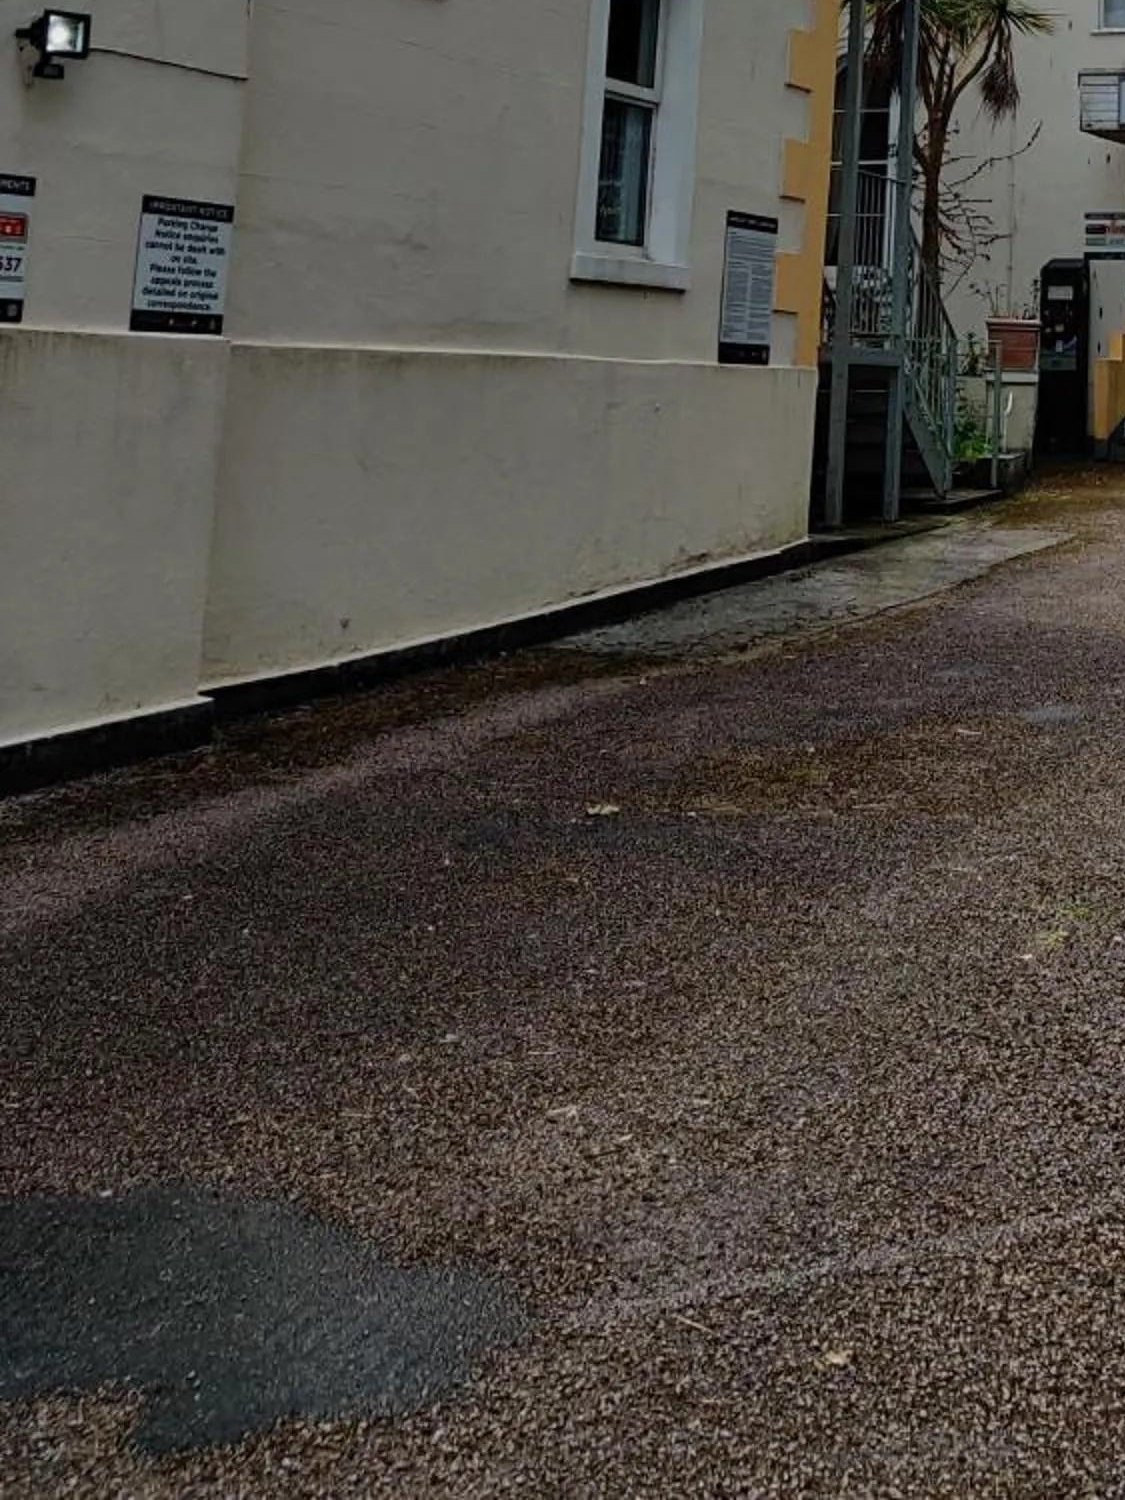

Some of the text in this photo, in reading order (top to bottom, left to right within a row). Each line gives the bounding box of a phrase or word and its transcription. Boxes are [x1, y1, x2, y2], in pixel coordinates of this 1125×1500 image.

[157, 218, 218, 233] Parking Charge
[155, 230, 181, 240] Notice
[145, 241, 225, 256] cannot be dealt with
[150, 263, 217, 277] Please follow the
[151, 277, 214, 289] appeals process
[142, 286, 176, 297] detailed
[189, 290, 219, 302] original
